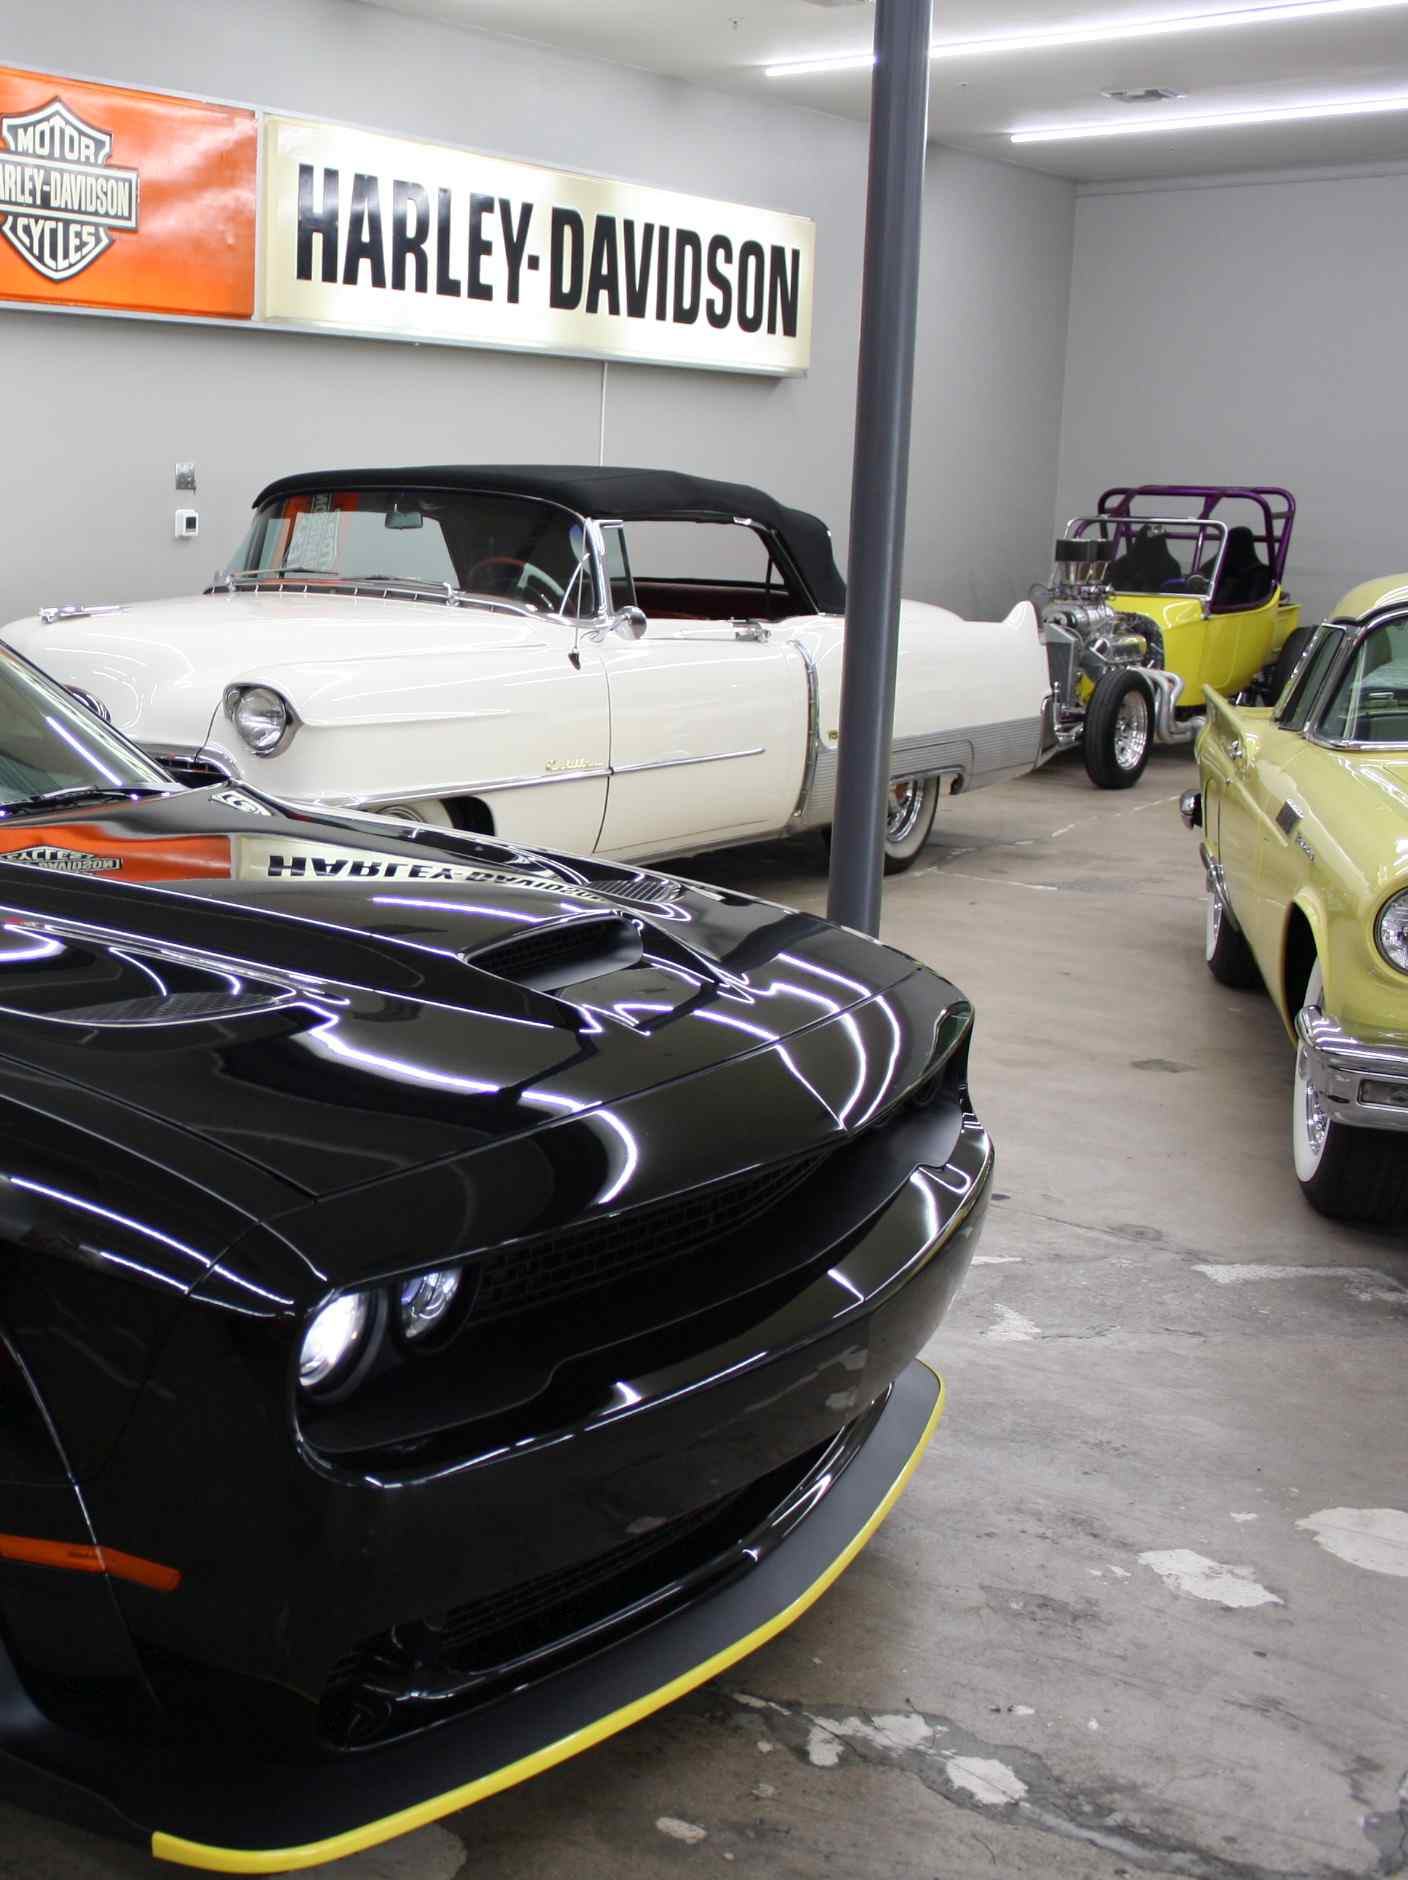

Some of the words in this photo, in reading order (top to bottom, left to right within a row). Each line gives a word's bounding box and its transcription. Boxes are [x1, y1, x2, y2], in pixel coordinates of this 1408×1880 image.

[16, 114, 96, 165] MOTOR
[16, 216, 96, 271] CYCLES
[296, 163, 801, 338] HARLEY-DAVIDSON
